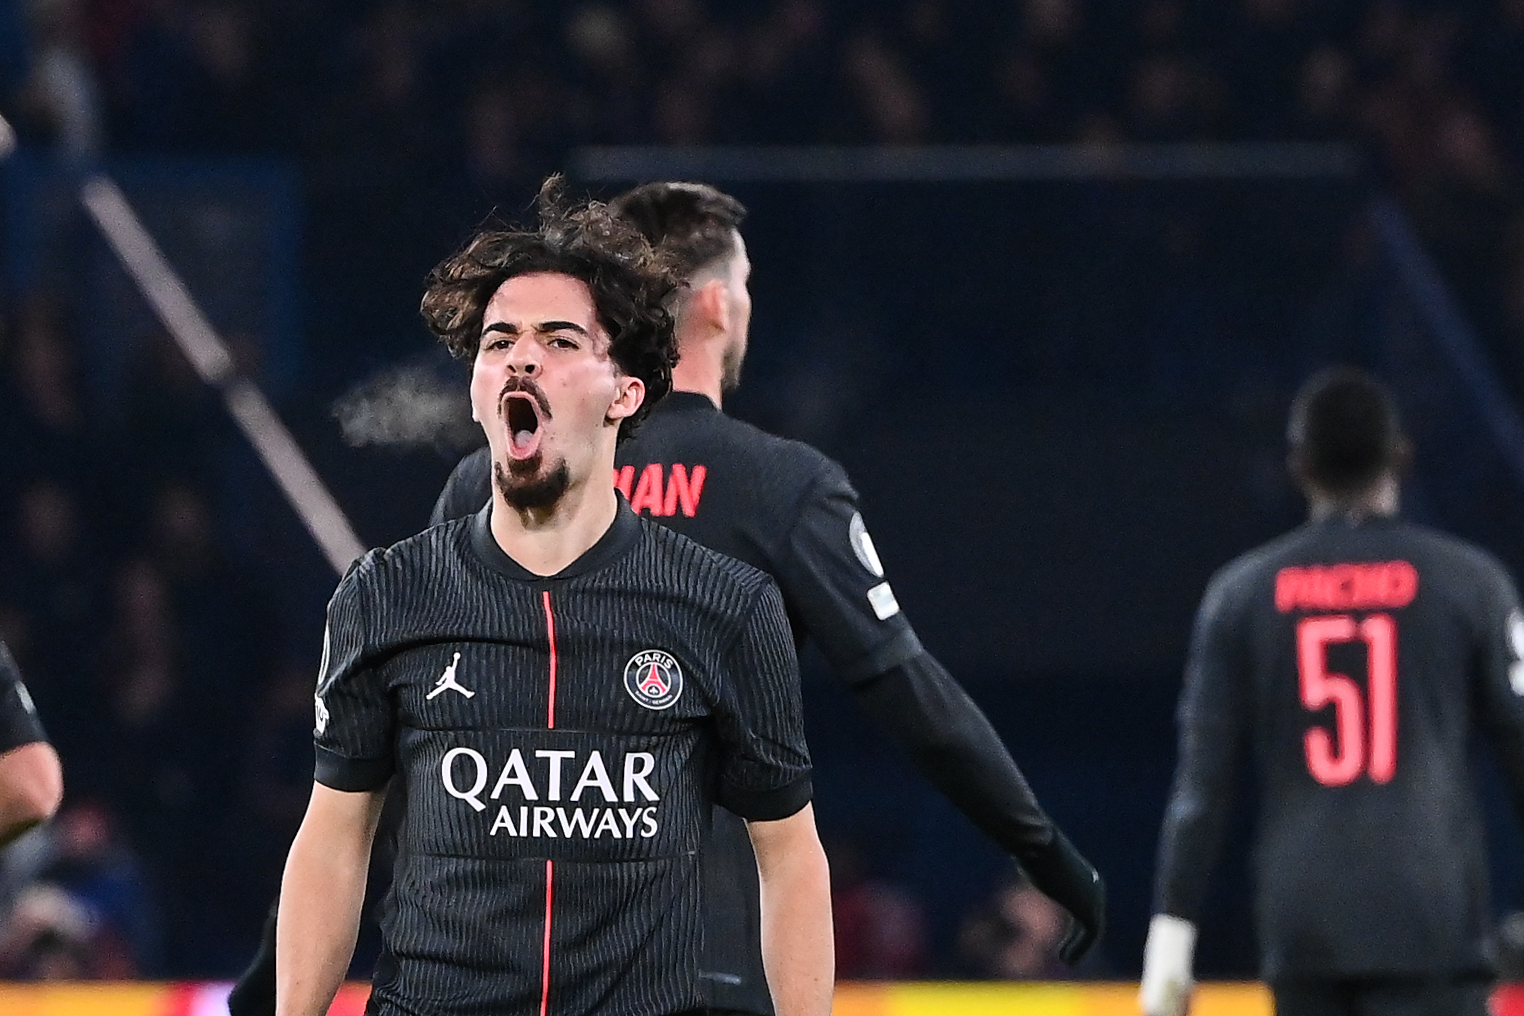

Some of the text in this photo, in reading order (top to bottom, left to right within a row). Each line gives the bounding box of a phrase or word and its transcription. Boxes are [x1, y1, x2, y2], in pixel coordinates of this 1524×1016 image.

[634, 652, 673, 669] PARIS
[1296, 613, 1398, 787] 51
[441, 747, 660, 812] QATAR
[489, 805, 658, 839] AIRWAYS
